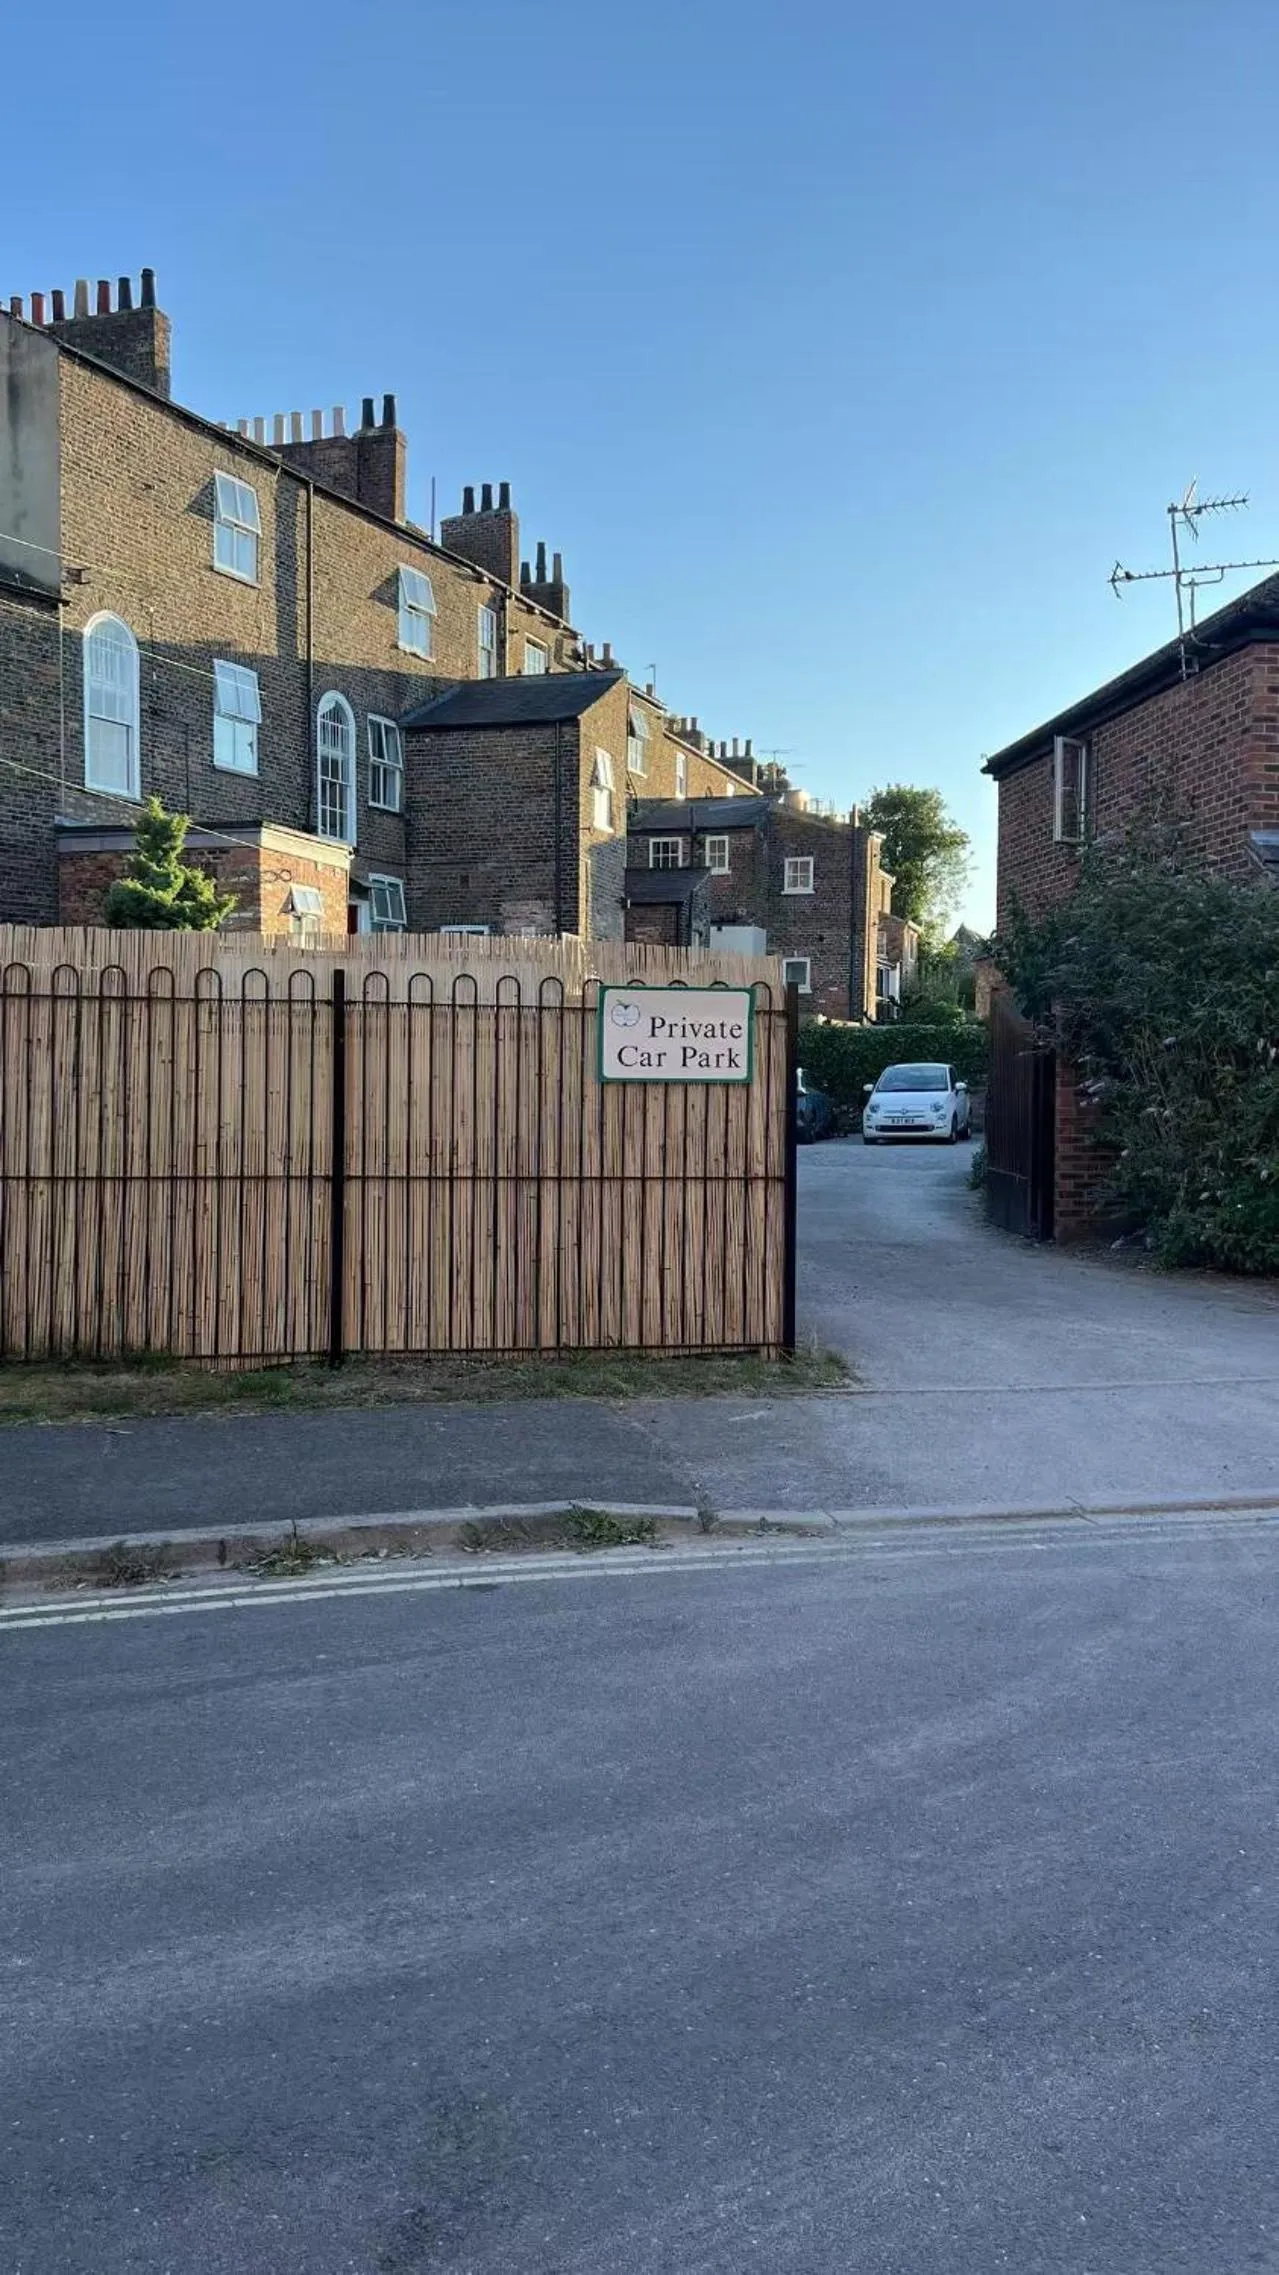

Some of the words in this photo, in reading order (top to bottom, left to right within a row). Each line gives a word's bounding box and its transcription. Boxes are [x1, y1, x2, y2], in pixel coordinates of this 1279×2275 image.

[649, 1016, 743, 1039] Private
[617, 1045, 667, 1067] Car
[680, 1046, 741, 1068] Park
